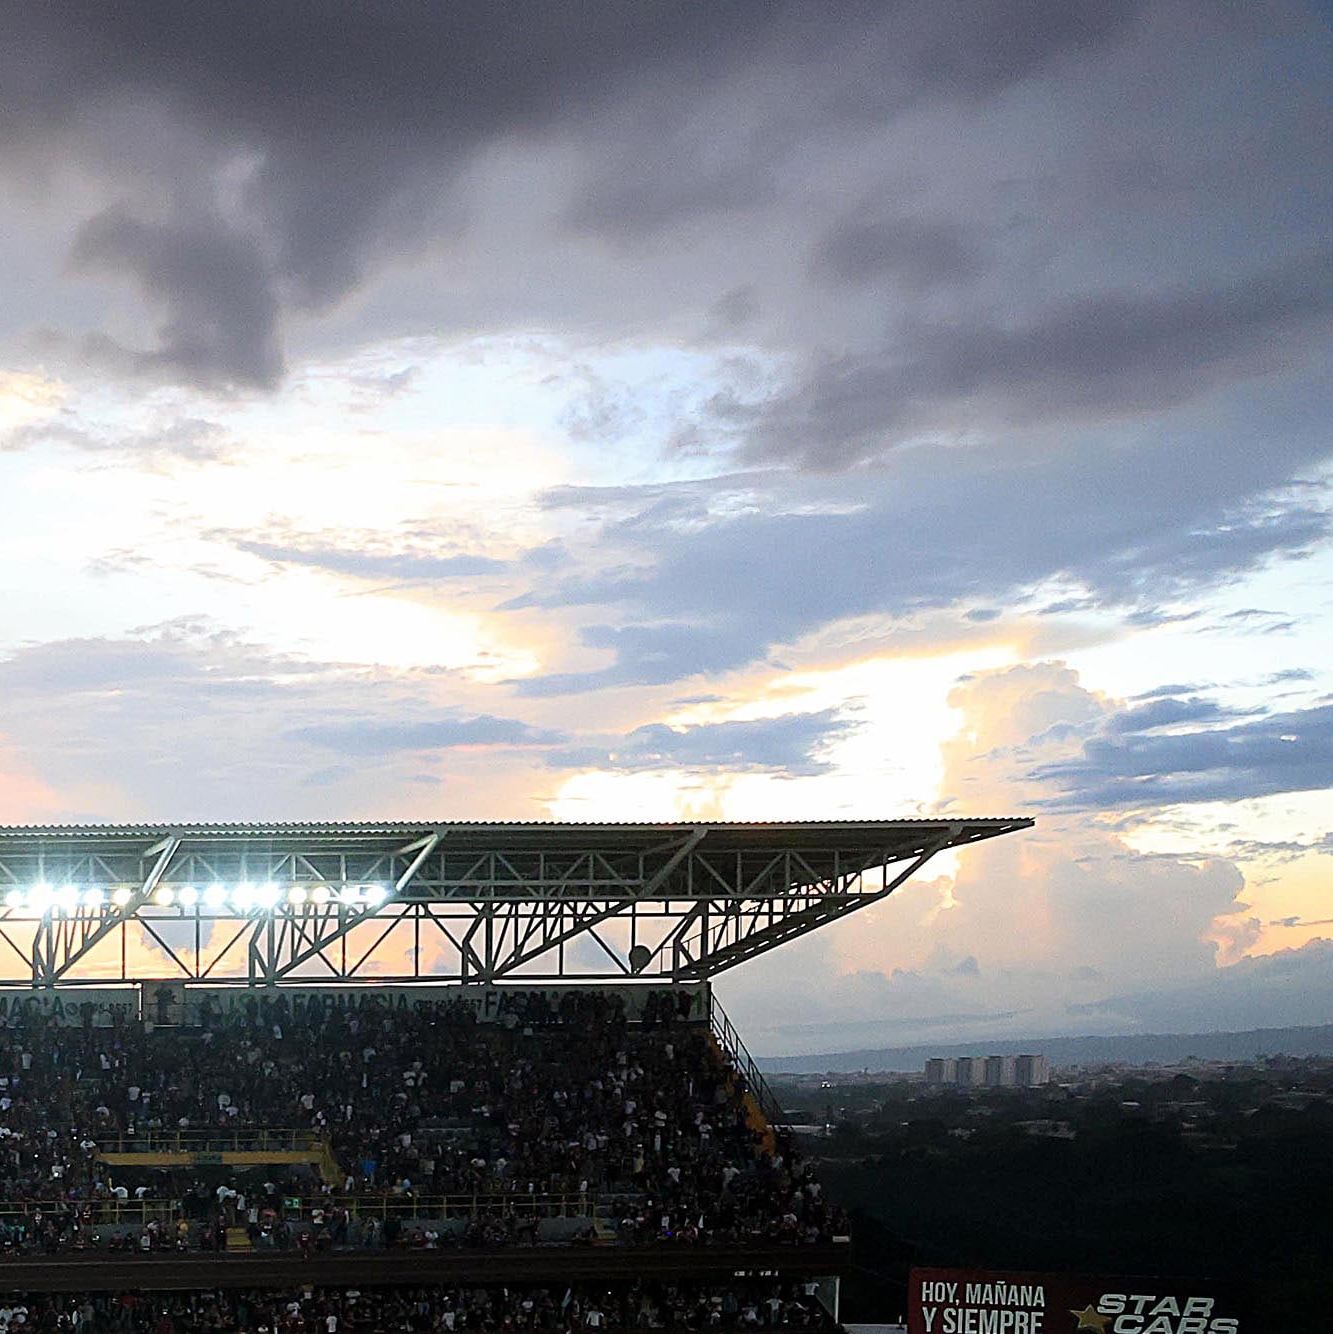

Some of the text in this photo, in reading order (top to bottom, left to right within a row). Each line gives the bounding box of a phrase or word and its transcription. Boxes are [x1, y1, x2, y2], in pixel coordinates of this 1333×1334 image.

[921, 1280, 1045, 1308] HOY, MAÑANA
[1096, 1293, 1215, 1318] STAR
[922, 1306, 937, 1333] Y
